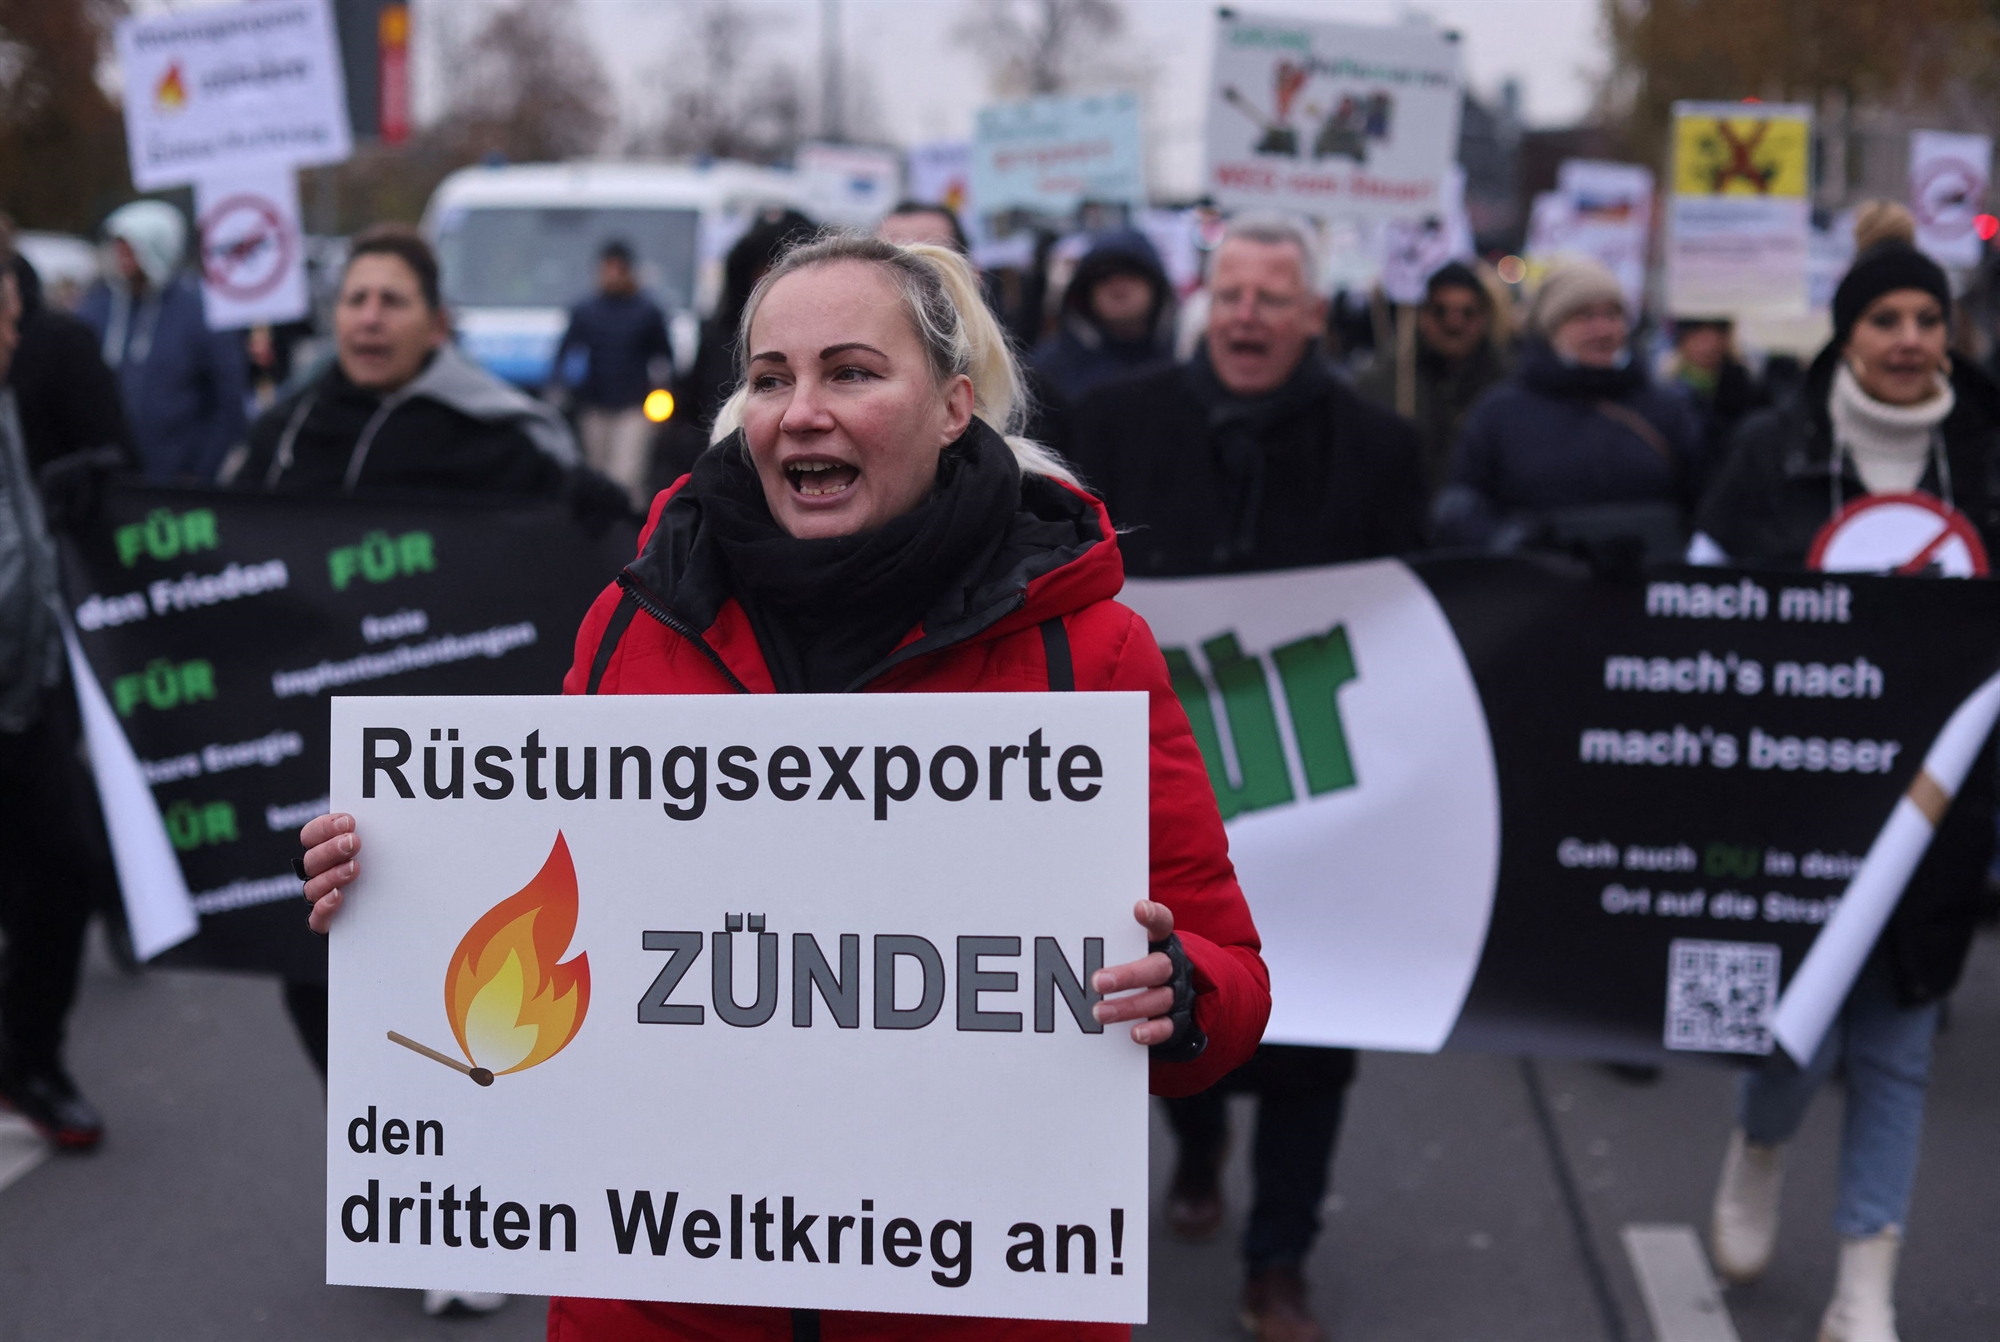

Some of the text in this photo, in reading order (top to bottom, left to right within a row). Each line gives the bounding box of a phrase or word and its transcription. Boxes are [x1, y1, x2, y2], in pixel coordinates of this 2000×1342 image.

[115, 508, 219, 567] FÜR
[328, 531, 436, 590] FÜR
[78, 560, 288, 630] den Frieden
[1646, 578, 1853, 622] mach mit
[113, 659, 214, 716] FÜR
[1605, 650, 1884, 699] mach's nach
[203, 730, 303, 773] Energie
[362, 727, 1103, 820] Rüstungsexporte
[1580, 724, 1899, 774] mach's besser
[165, 801, 238, 849] ÜR
[1557, 837, 1619, 869] Geh
[1623, 844, 1697, 873] auch
[1703, 843, 1760, 879] DU
[1763, 848, 1796, 877] in
[1602, 884, 1651, 915] Ort
[1655, 889, 1706, 917] auf
[1709, 891, 1758, 921] die
[638, 912, 1105, 1034] ZÜNDEN
[348, 1106, 443, 1155] den
[342, 1179, 1123, 1288] dritten Weltkrieg an!
